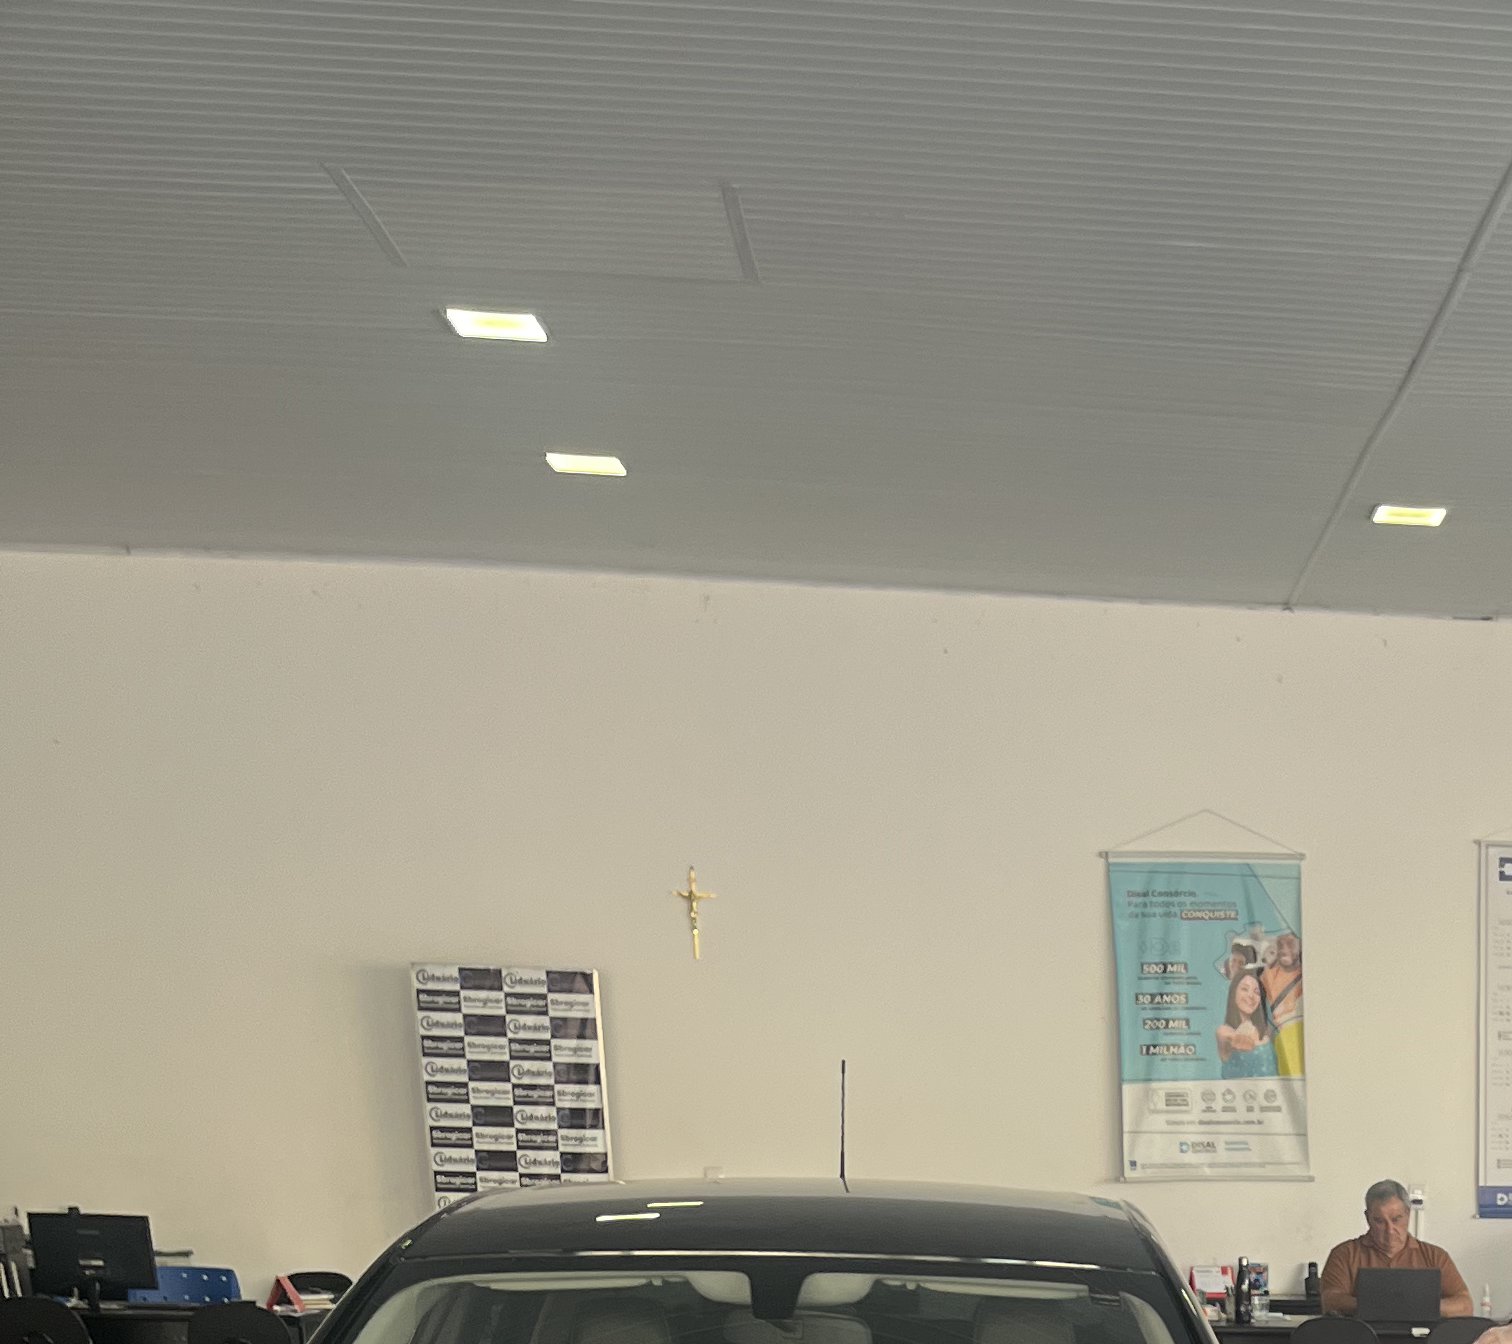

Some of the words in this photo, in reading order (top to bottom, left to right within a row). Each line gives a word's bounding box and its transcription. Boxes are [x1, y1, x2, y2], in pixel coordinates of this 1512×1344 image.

[1142, 963, 1165, 974] 500
[1166, 963, 1187, 974] MIL
[1153, 994, 1187, 1004] ANOS
[1144, 1019, 1166, 1030] 200
[1168, 1019, 1189, 1029] MIL
[1149, 1043, 1195, 1056] MILHÃO
